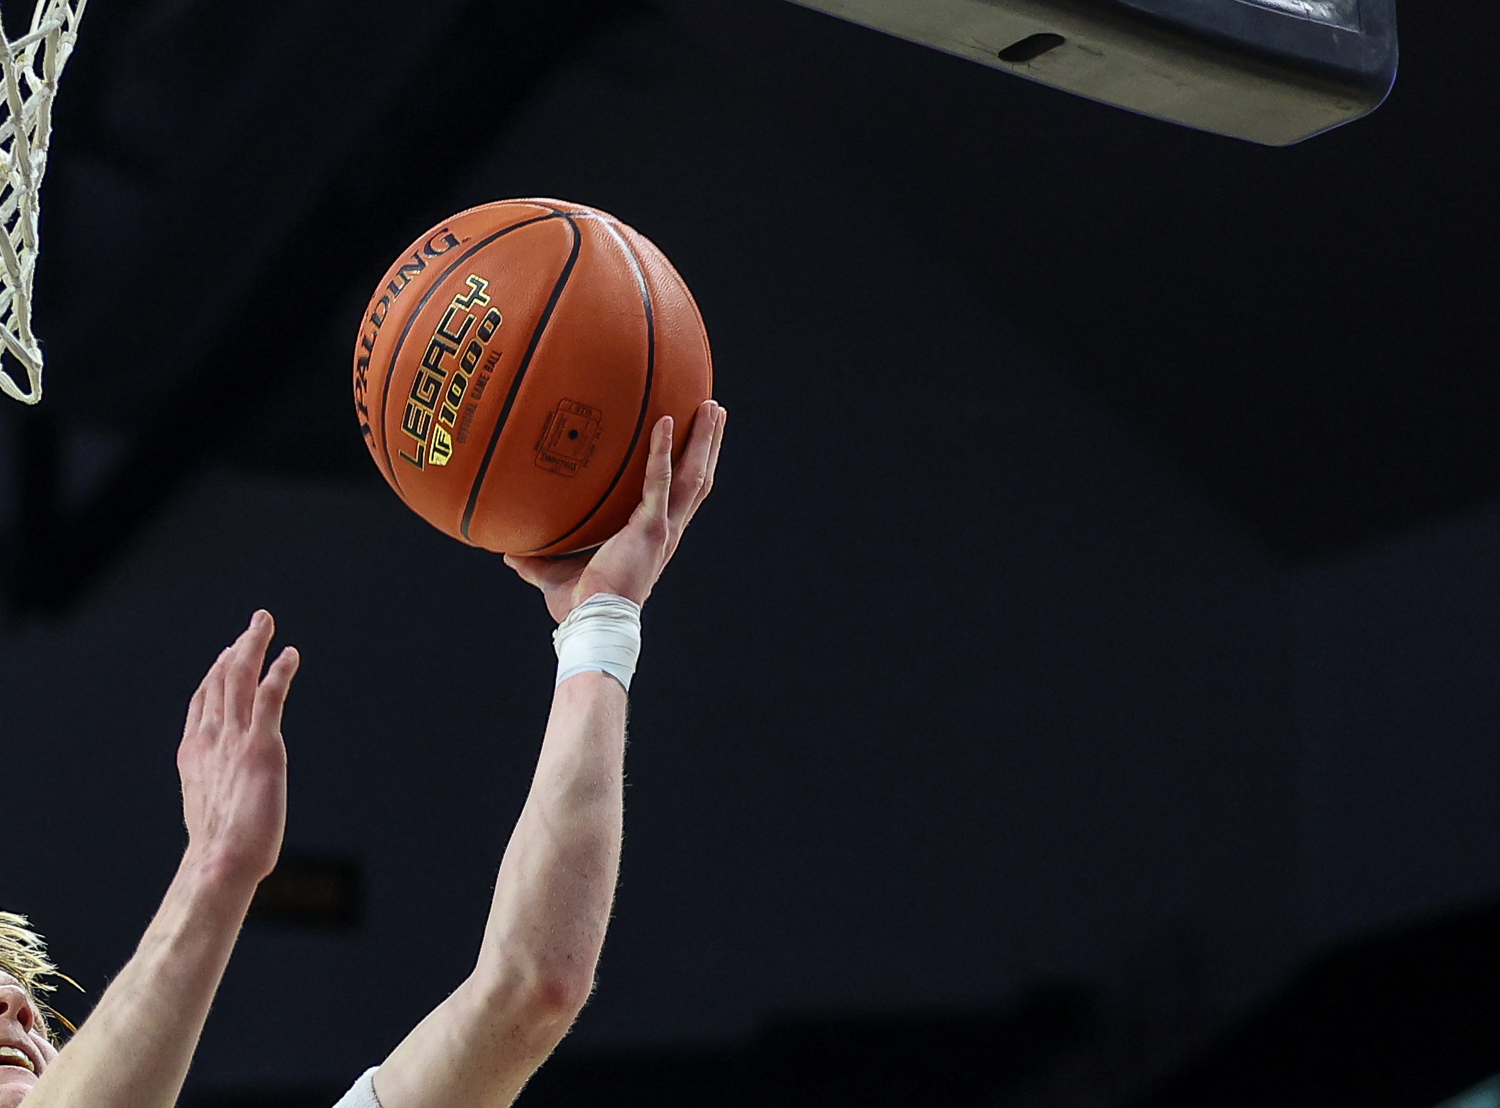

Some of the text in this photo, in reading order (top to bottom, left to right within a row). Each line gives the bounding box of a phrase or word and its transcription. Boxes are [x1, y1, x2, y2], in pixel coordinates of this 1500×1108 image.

[400, 274, 491, 471] LEGACY
[429, 306, 502, 466] TF 1000
[472, 372, 490, 401] GAME
[484, 349, 503, 373] BALL
